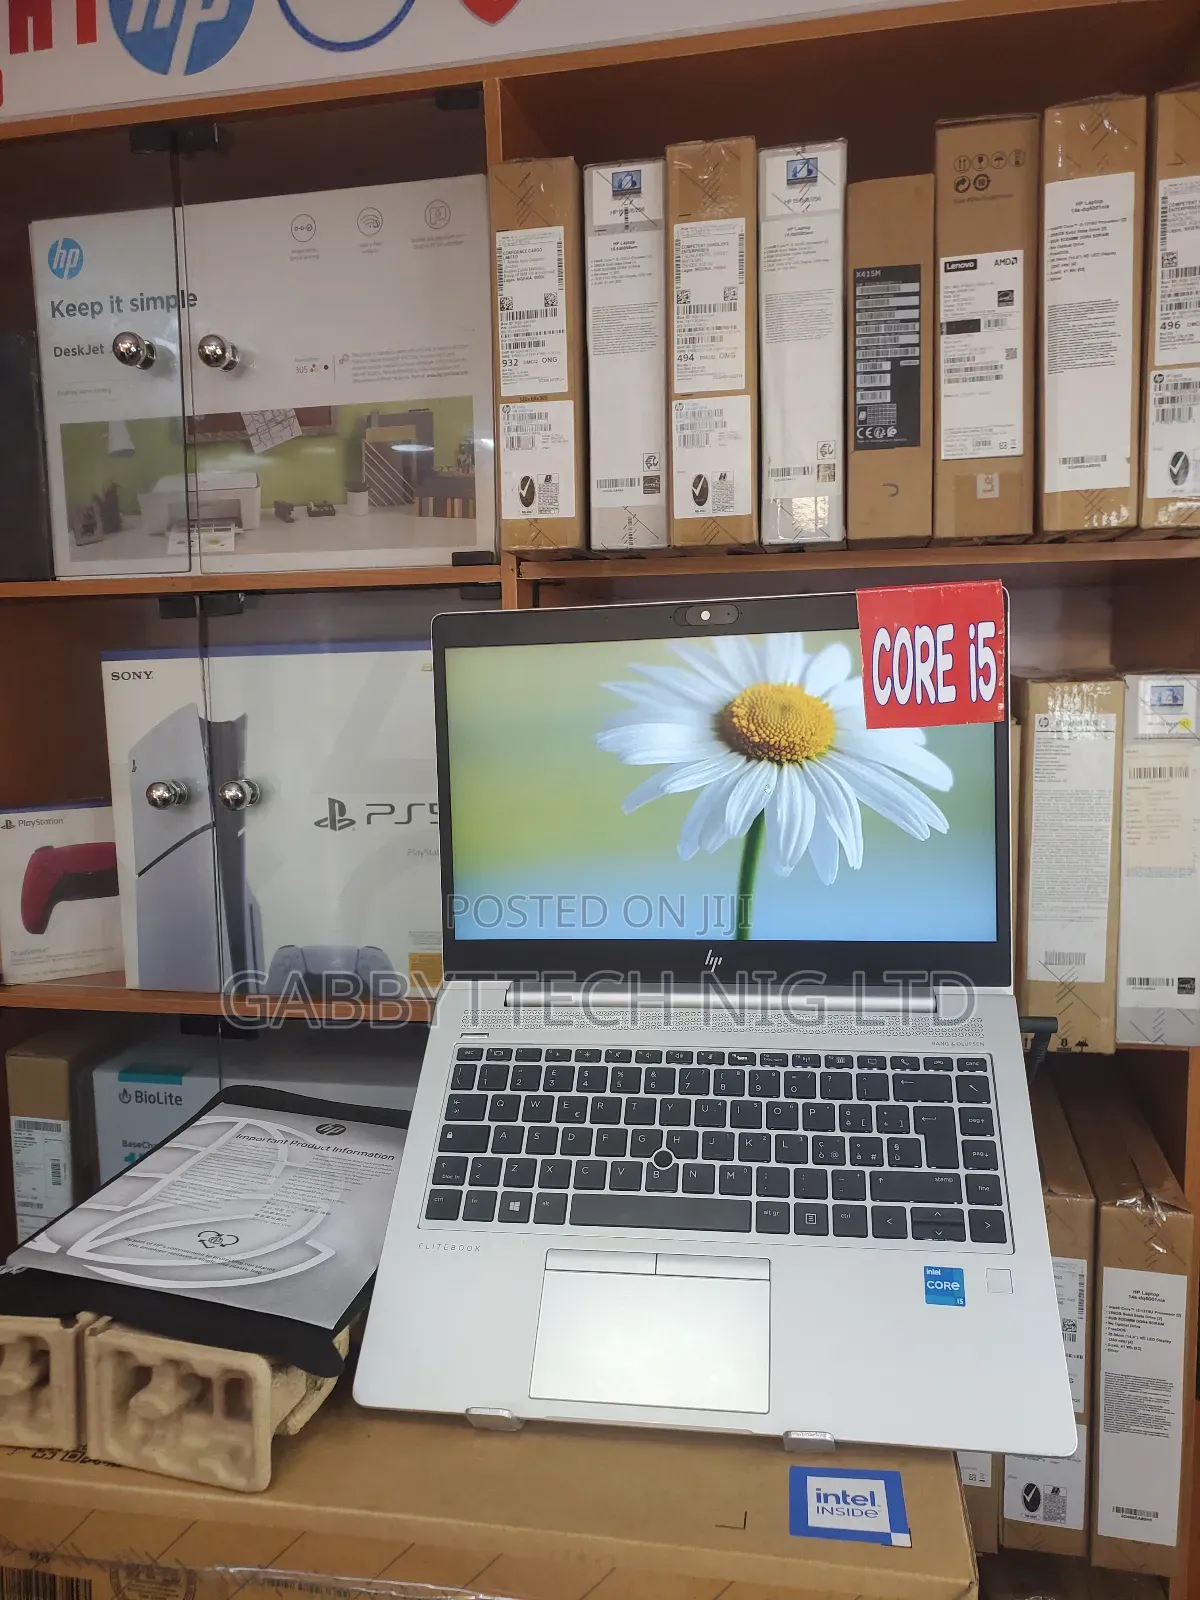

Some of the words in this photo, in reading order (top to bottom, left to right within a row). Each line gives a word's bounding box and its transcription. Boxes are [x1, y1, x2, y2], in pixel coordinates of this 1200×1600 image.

[50, 237, 82, 279] hp
[994, 257, 1011, 266] AMD
[946, 260, 975, 271] Lenovo
[856, 269, 881, 278] X415M
[51, 299, 103, 320] Keep
[109, 295, 124, 315] it
[129, 289, 198, 314] simple
[1160, 321, 1181, 330] 496
[53, 343, 105, 358] DeskJet
[502, 358, 519, 367] 932
[542, 356, 558, 364] ONG
[677, 353, 695, 362] 494
[295, 365, 308, 374] 305
[872, 623, 957, 706] CORE
[968, 620, 997, 703] i5
[111, 671, 153, 681] SONY
[18, 816, 64, 828] PlayStation
[704, 949, 723, 972] hp
[134, 1090, 183, 1106] BioLite
[315, 1123, 347, 1136] hp
[236, 1133, 288, 1145] Important
[290, 1140, 331, 1152] Product
[332, 1146, 395, 1161] Information
[419, 1243, 481, 1252] ELITEBOOK
[1142, 1290, 1160, 1298] Laptop
